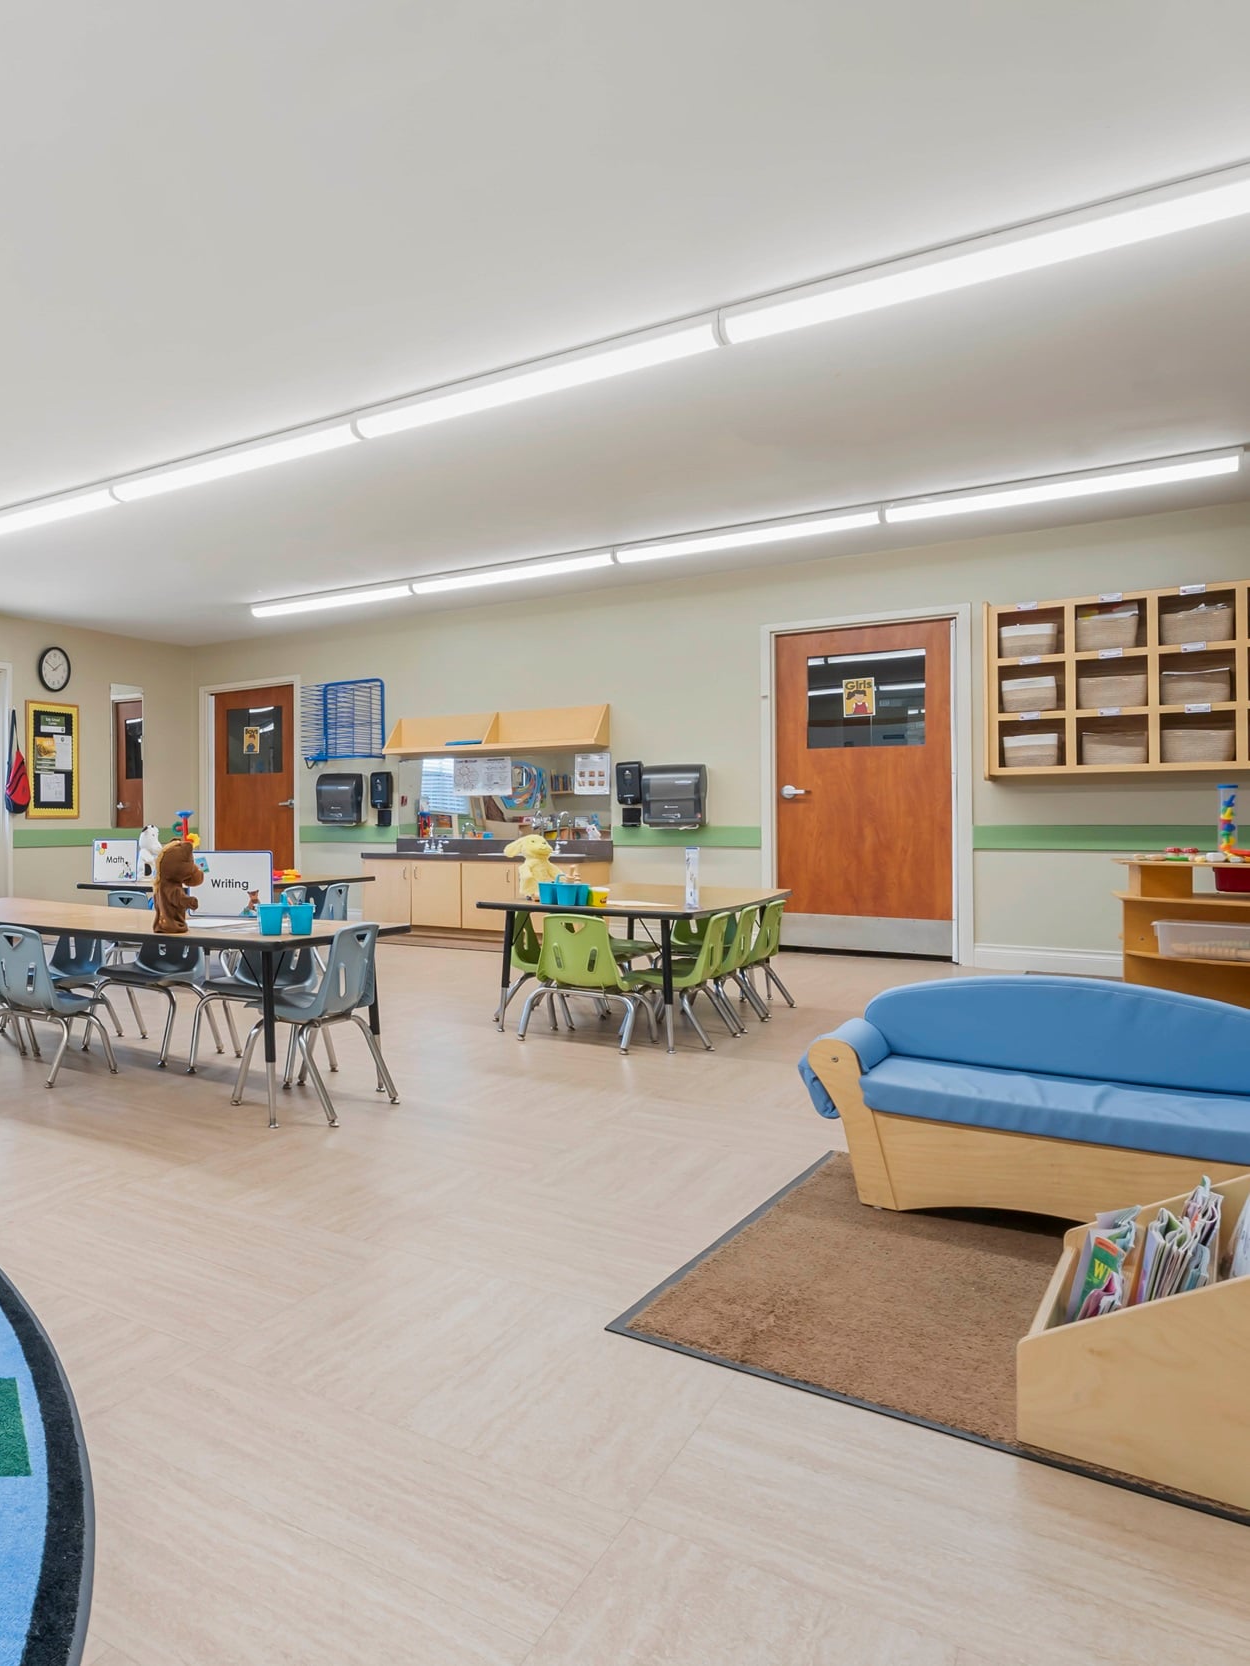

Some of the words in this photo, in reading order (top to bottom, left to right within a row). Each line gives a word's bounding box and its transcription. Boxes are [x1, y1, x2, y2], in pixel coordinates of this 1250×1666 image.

[845, 679, 872, 690] Girls
[105, 855, 125, 864] Math
[210, 878, 249, 891] Writing
